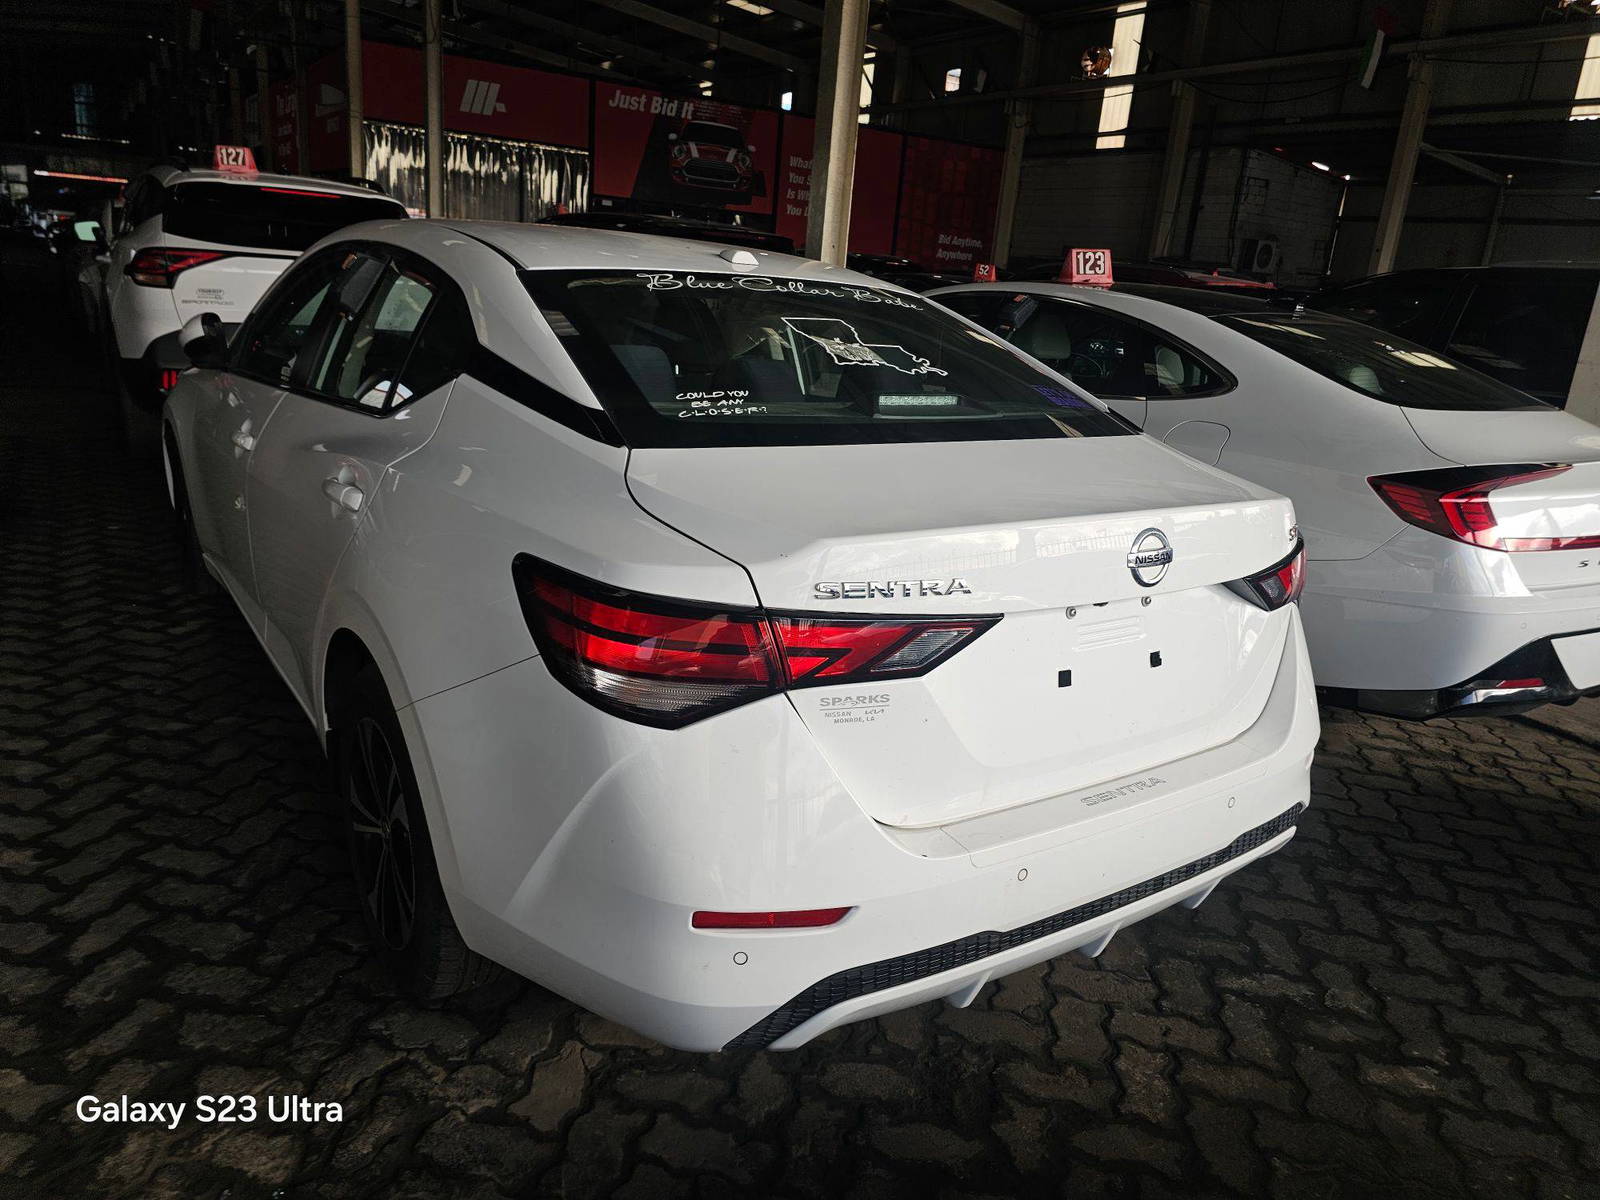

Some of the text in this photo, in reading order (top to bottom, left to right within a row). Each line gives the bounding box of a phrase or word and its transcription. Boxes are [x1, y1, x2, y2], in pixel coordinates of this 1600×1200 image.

[608, 89, 647, 112] Just
[650, 96, 678, 117] Bid
[681, 101, 694, 120] It
[220, 147, 244, 166] 127
[788, 172, 805, 185] You
[786, 188, 796, 200] Is
[786, 203, 803, 217] You
[938, 234, 952, 245] Bid
[979, 264, 990, 276] 52
[1076, 251, 1105, 275] 123
[636, 273, 923, 311] Blue Collar Babe
[675, 389, 749, 400] COULD YOU
[690, 398, 744, 408] BE ANY
[1135, 552, 1171, 565] NISSAN
[814, 577, 972, 600] SENTRA
[819, 693, 891, 707] SPARKS
[1080, 777, 1166, 807] SENTRA
